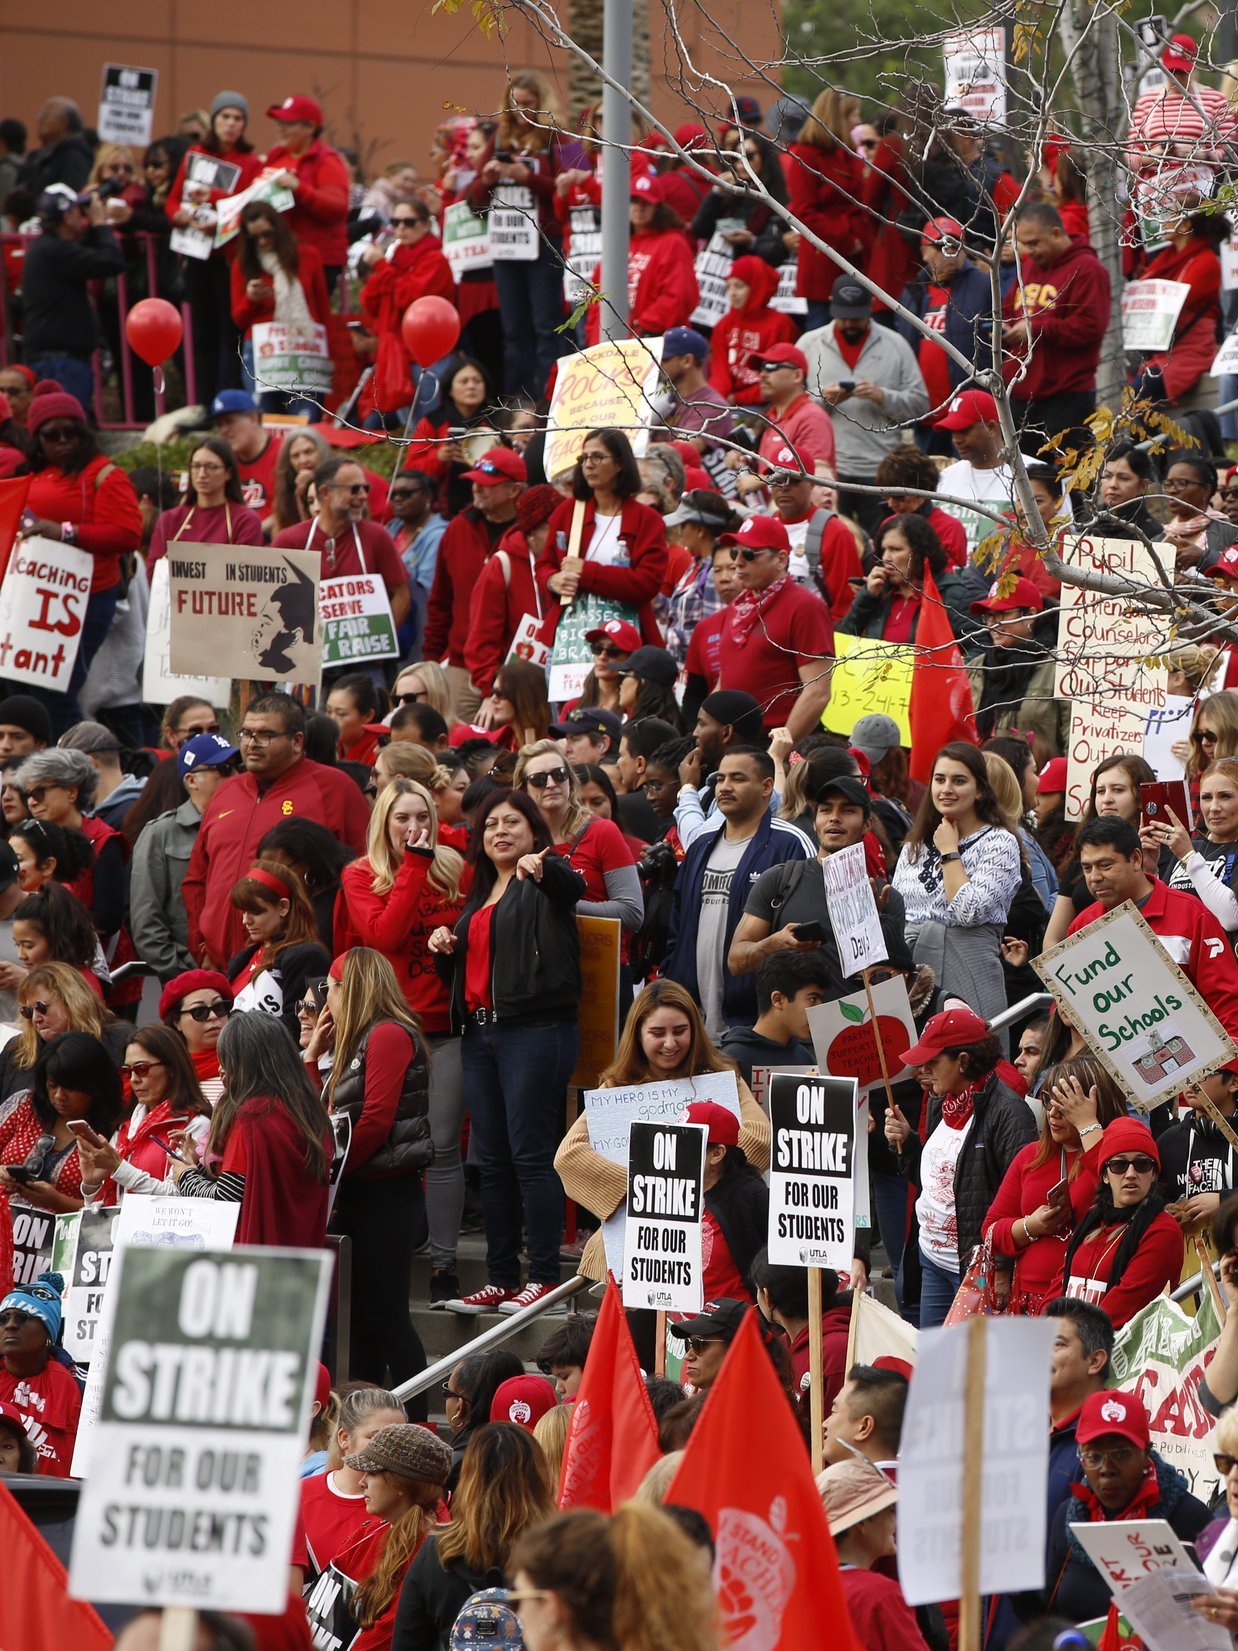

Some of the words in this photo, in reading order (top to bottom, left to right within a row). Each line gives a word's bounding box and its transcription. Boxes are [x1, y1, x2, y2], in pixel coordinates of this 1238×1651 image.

[1078, 539, 1135, 571] Pupil
[171, 560, 207, 579] INVEST
[225, 563, 237, 581] IN
[238, 564, 288, 584] STUDENTS
[177, 589, 257, 617] FUTURE
[319, 580, 375, 601] CATORS
[28, 588, 81, 637] IS
[319, 600, 364, 620] SERVE
[327, 618, 371, 640] FAIR
[1066, 616, 1161, 646] Counselors
[339, 634, 391, 657] RAISE
[832, 689, 909, 716] 13-241-7
[1100, 671, 1167, 708] Students
[1092, 701, 1129, 720] Keep
[1072, 717, 1146, 744] Privatizers
[1073, 740, 1107, 764] Out
[1170, 882, 1195, 891] INDUSTR
[1055, 941, 1122, 996] Fund
[1092, 973, 1134, 1014] our
[1098, 994, 1183, 1052] Schools
[591, 1096, 611, 1107] MY
[615, 1091, 644, 1105] HERO
[648, 1092, 658, 1101] IS
[662, 1088, 679, 1098] MY
[796, 1084, 825, 1125] ON
[593, 1137, 610, 1151] MY
[653, 1132, 677, 1171] ON
[777, 1128, 848, 1172] STRIKE
[1176, 1170, 1216, 1186] NOTH
[632, 1174, 696, 1217] STRIKE
[784, 1181, 809, 1207] FOR
[812, 1183, 838, 1209] OUR
[13, 1214, 50, 1249] ON
[637, 1226, 659, 1251] FOR
[662, 1228, 687, 1254] OUR
[777, 1212, 845, 1243] STUDENTS
[809, 1249, 827, 1258] UTLA
[631, 1256, 691, 1286] STUDENTS
[179, 1259, 259, 1340] ON
[656, 1291, 672, 1301] UTLA
[111, 1339, 299, 1428] STRIKE
[125, 1445, 186, 1490] FOR
[196, 1449, 262, 1495] OUR
[99, 1504, 269, 1558] STUDENTS
[308, 1571, 343, 1619] ON
